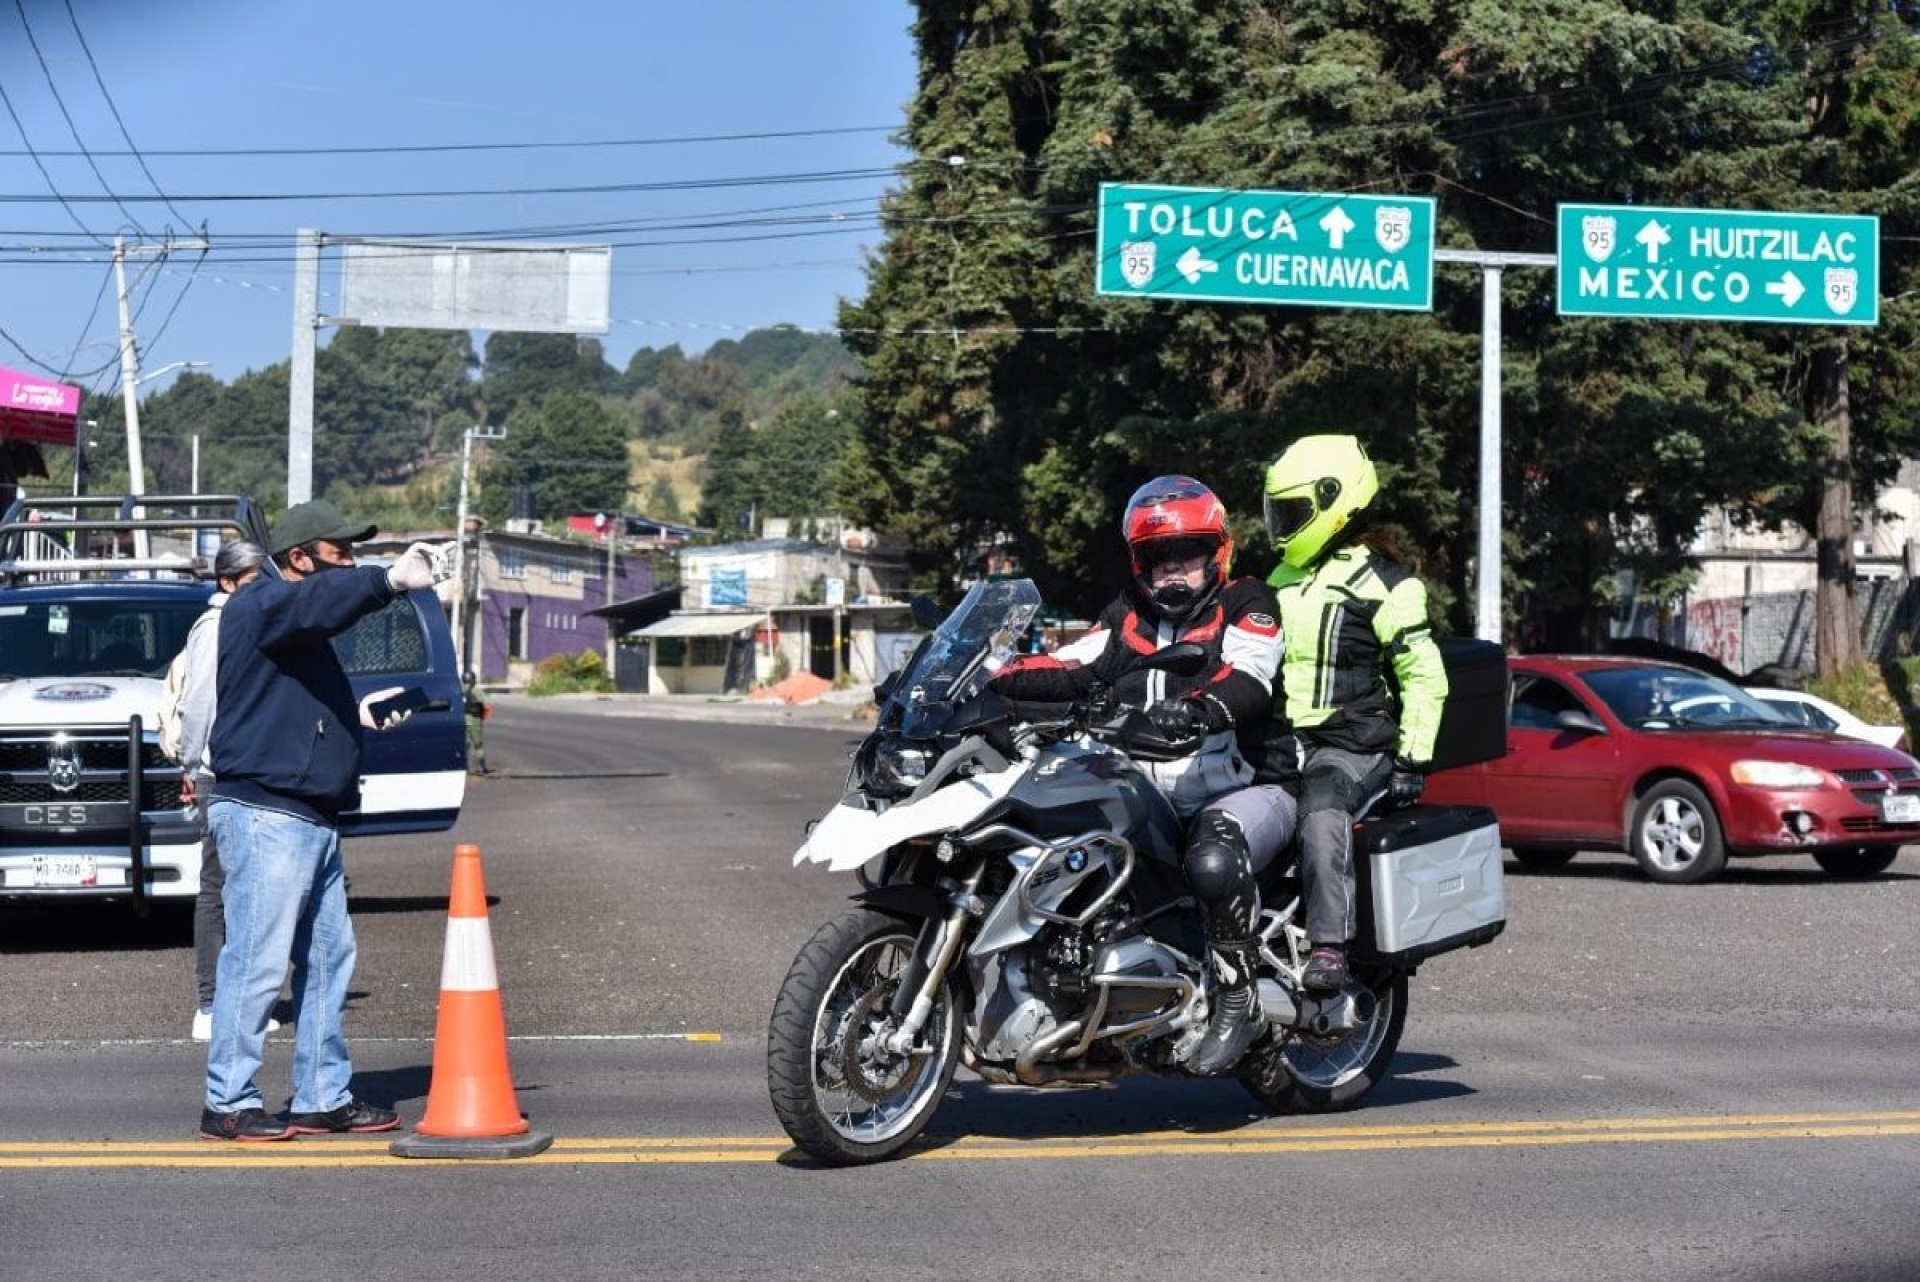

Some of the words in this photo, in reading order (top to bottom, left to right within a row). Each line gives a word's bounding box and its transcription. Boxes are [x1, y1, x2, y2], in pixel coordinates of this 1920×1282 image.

[1123, 202, 1298, 241] TOLUCA
[1382, 222, 1404, 242] 95
[1588, 231, 1610, 250] 95
[1689, 226, 1857, 263] HUITZILAC
[1127, 257, 1150, 276] 95
[1235, 253, 1411, 291] CUERNAVACA
[1578, 266, 1751, 303] MEXICO
[1830, 284, 1852, 303] 95
[24, 806, 87, 824] CES
